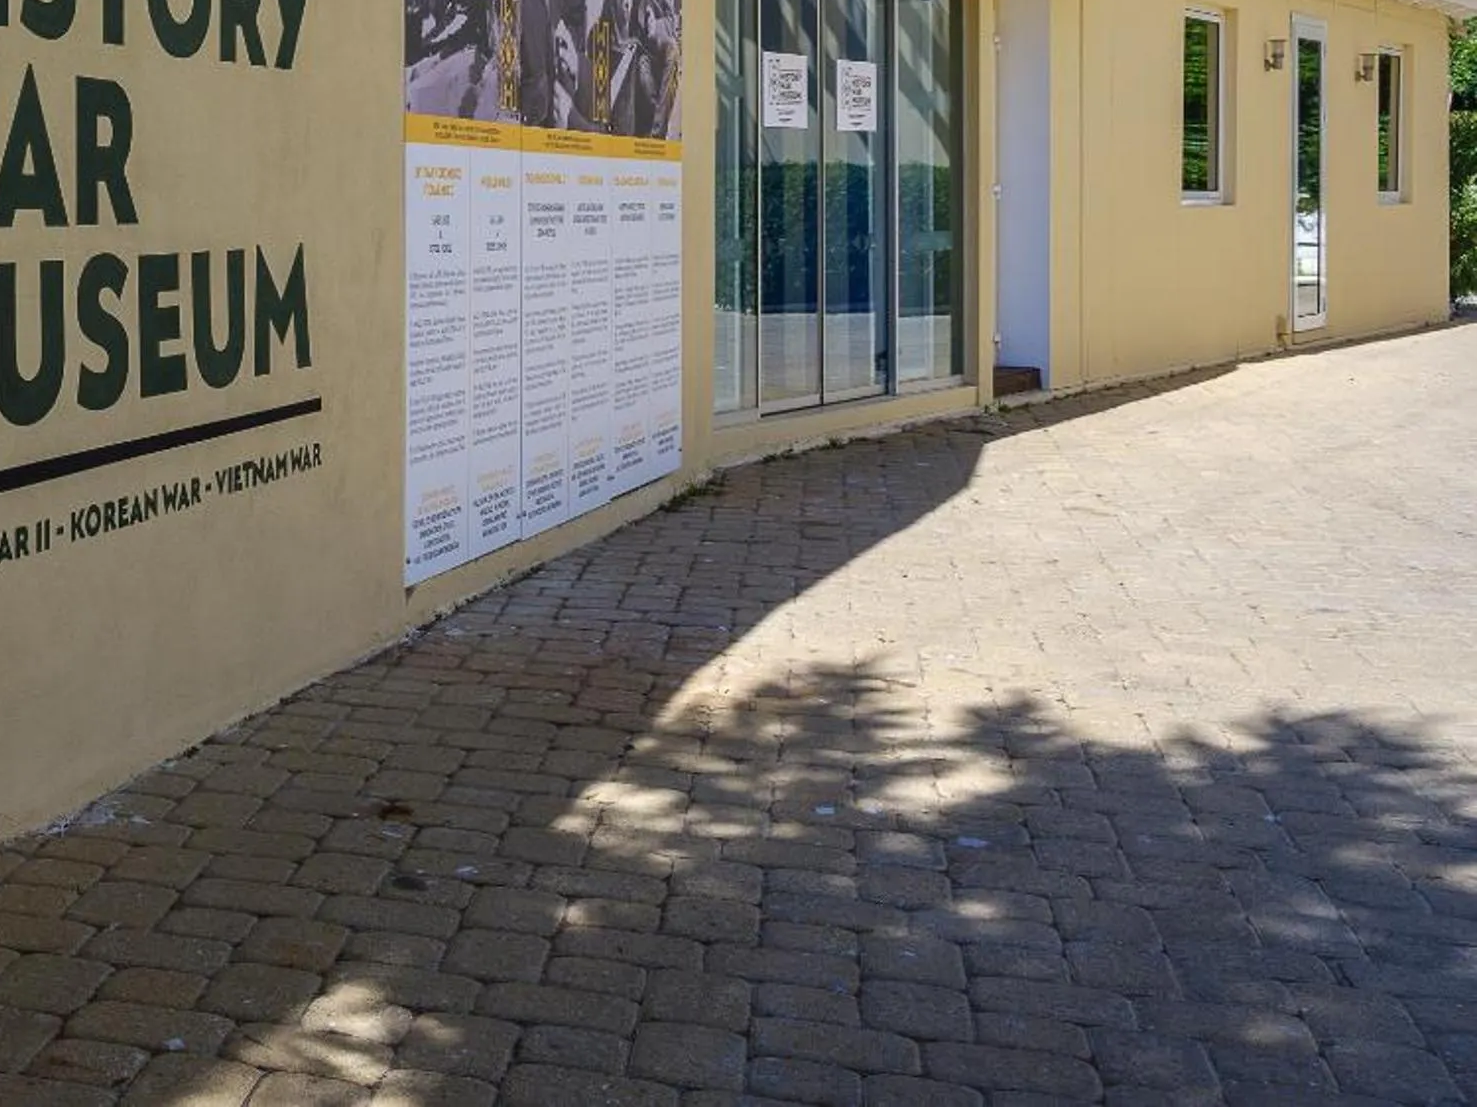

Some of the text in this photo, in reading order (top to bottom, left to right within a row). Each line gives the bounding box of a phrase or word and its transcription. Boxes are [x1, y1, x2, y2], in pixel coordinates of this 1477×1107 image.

[35, 518, 51, 553] II
[70, 488, 159, 543] KOREAN
[162, 477, 202, 514] WAR
[215, 453, 289, 494] VIETNAM
[289, 443, 322, 473] WAR
